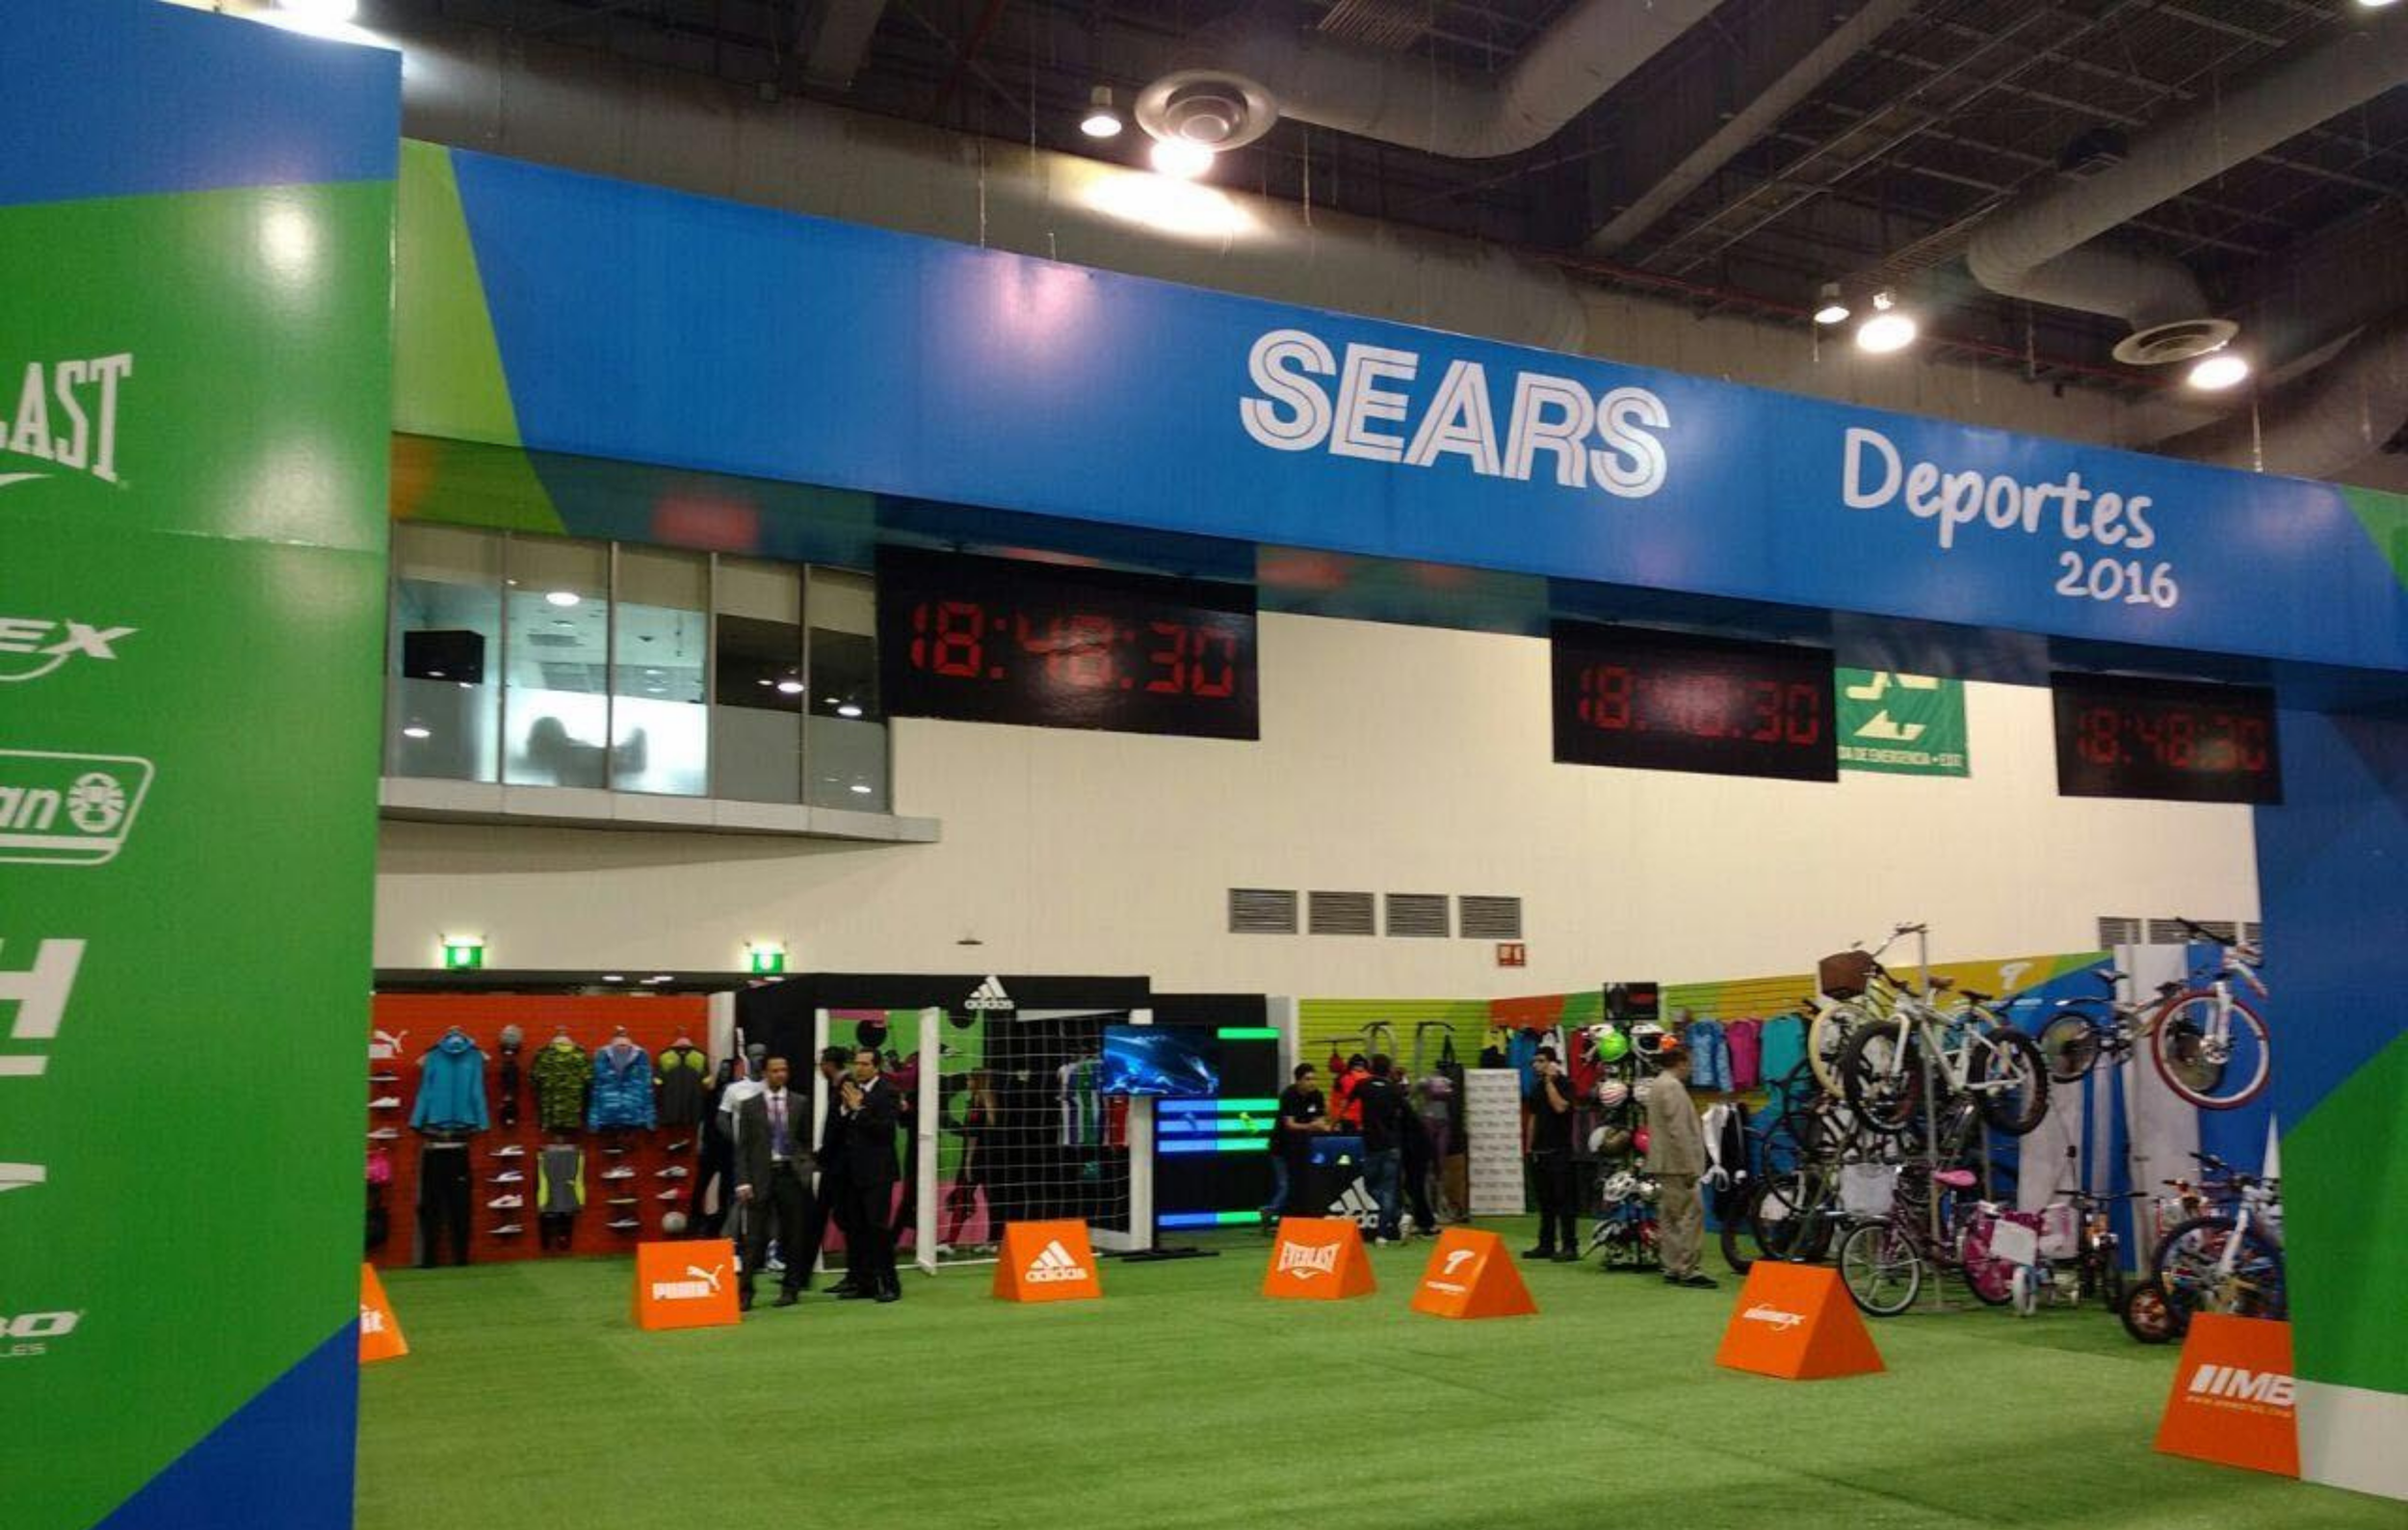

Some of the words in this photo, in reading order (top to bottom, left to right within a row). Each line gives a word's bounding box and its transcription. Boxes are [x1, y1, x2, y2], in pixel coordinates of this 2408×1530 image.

[1240, 329, 1670, 499] SEARS
[1843, 427, 2156, 549] Deportes
[2055, 550, 2180, 609] 2016
[964, 997, 1015, 1010] adidas
[1024, 1264, 1088, 1282] adidas
